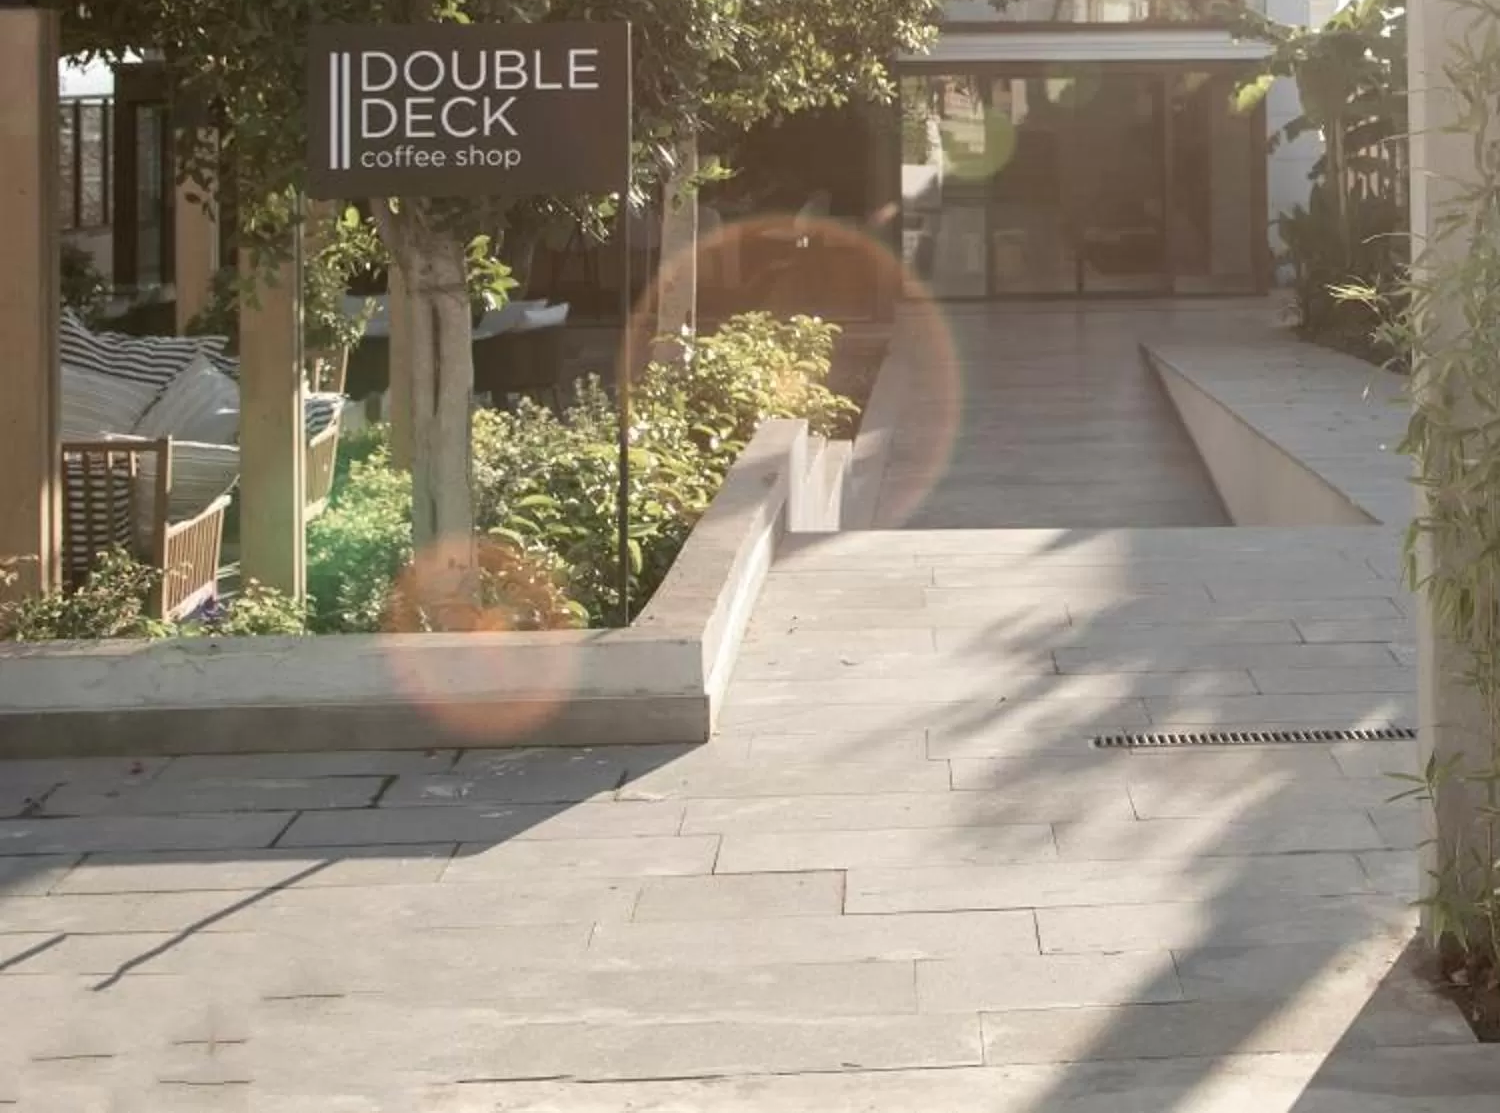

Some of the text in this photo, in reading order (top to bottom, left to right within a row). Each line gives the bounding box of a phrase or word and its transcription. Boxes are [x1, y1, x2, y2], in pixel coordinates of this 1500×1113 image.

[361, 49, 599, 92] DOUBLE
[361, 96, 519, 138] DECK
[360, 145, 522, 170] coffee shop
